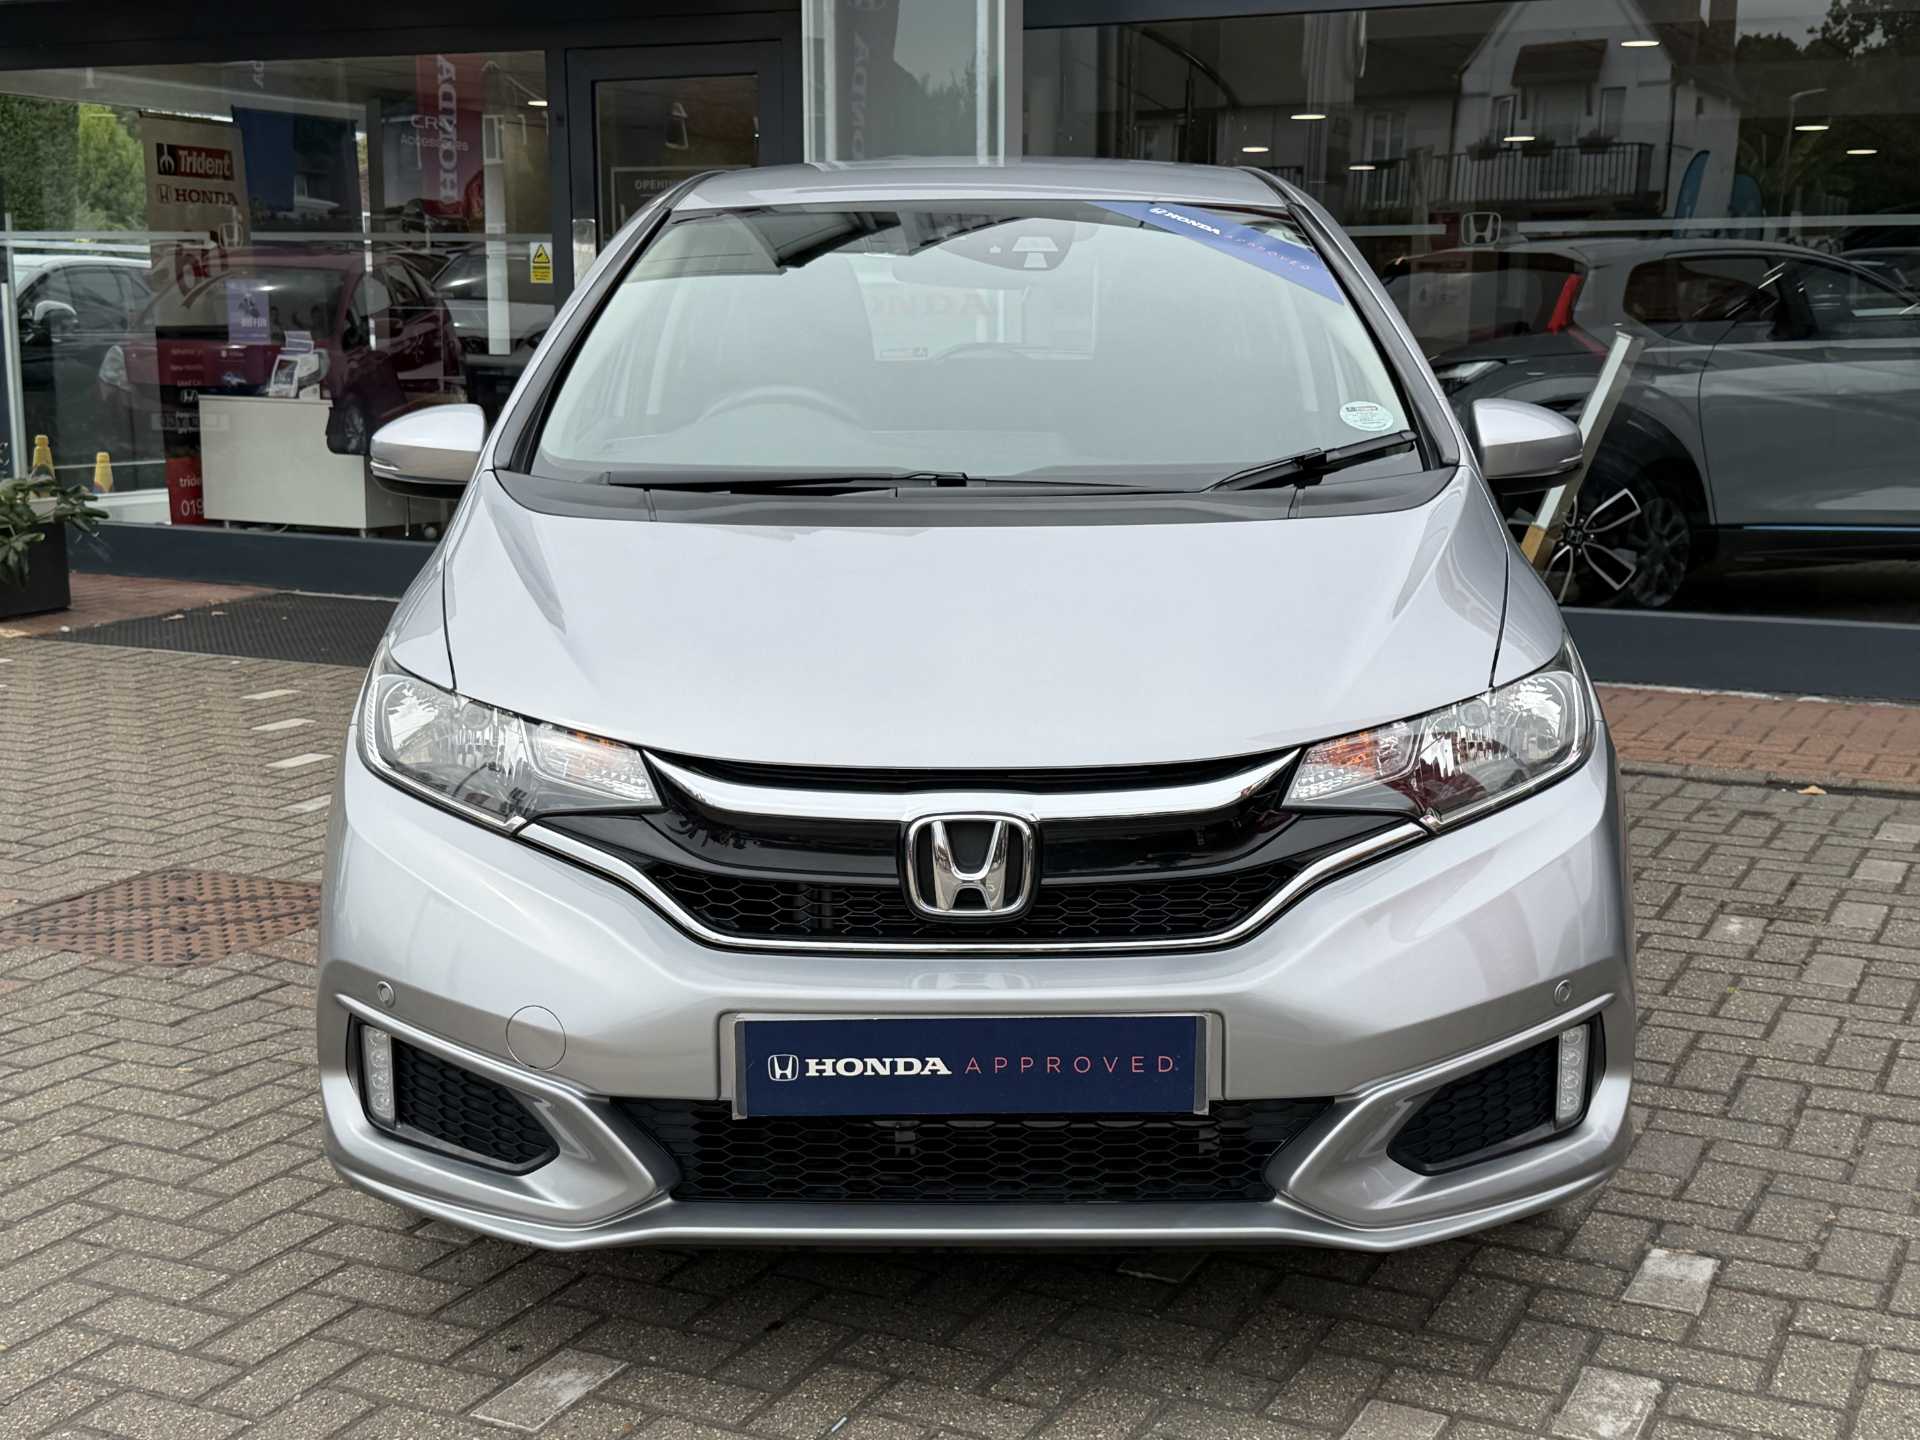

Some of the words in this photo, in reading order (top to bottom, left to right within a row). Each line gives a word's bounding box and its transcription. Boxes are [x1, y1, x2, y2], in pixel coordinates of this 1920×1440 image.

[178, 149, 232, 177] Trident
[174, 187, 239, 206] HONDA
[1165, 212, 1221, 235] HONDA
[805, 1057, 952, 1077] HONDA
[964, 1056, 1174, 1074] APPROVED
